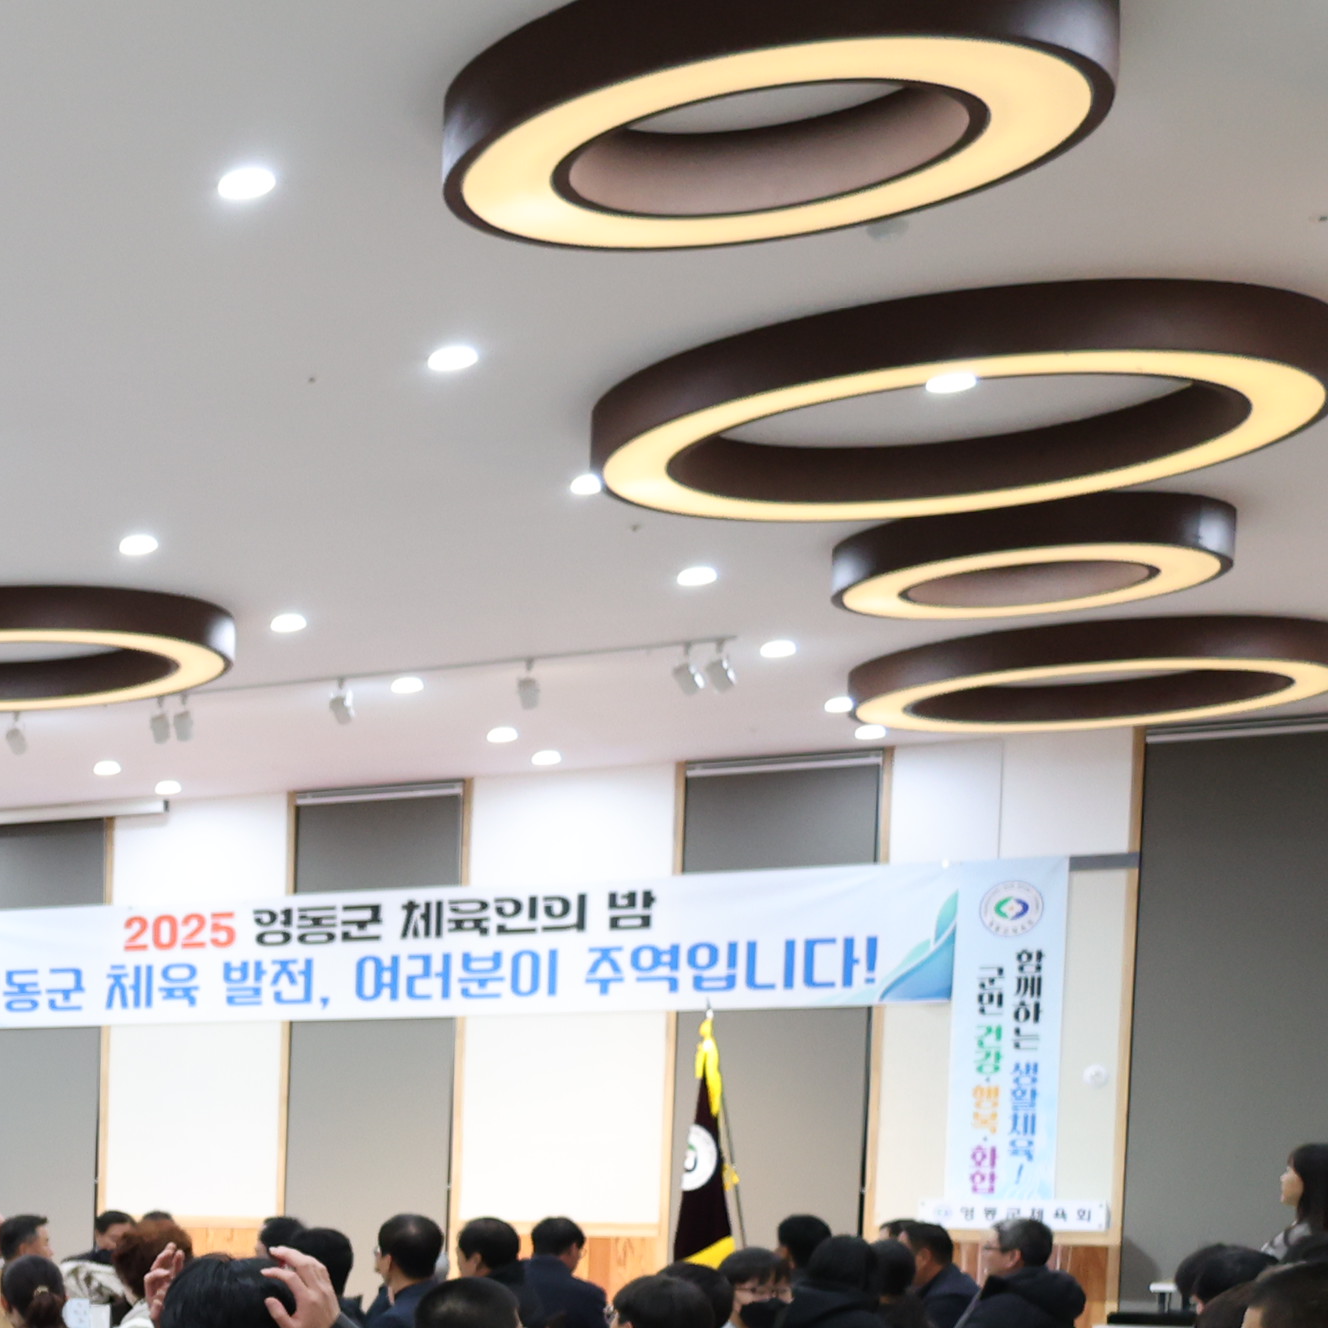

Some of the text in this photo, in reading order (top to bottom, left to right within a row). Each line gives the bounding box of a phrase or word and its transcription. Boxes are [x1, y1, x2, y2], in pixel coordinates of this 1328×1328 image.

[123, 890, 656, 952] 2025 영동군 체육인의 밤
[105, 962, 200, 1010] 체육
[224, 958, 331, 1010] 발전,
[355, 948, 559, 1002] 여러분이
[585, 936, 880, 996] 주역입니다!
[977, 965, 1004, 1016] 군민
[1012, 949, 1045, 1051] 함께하는
